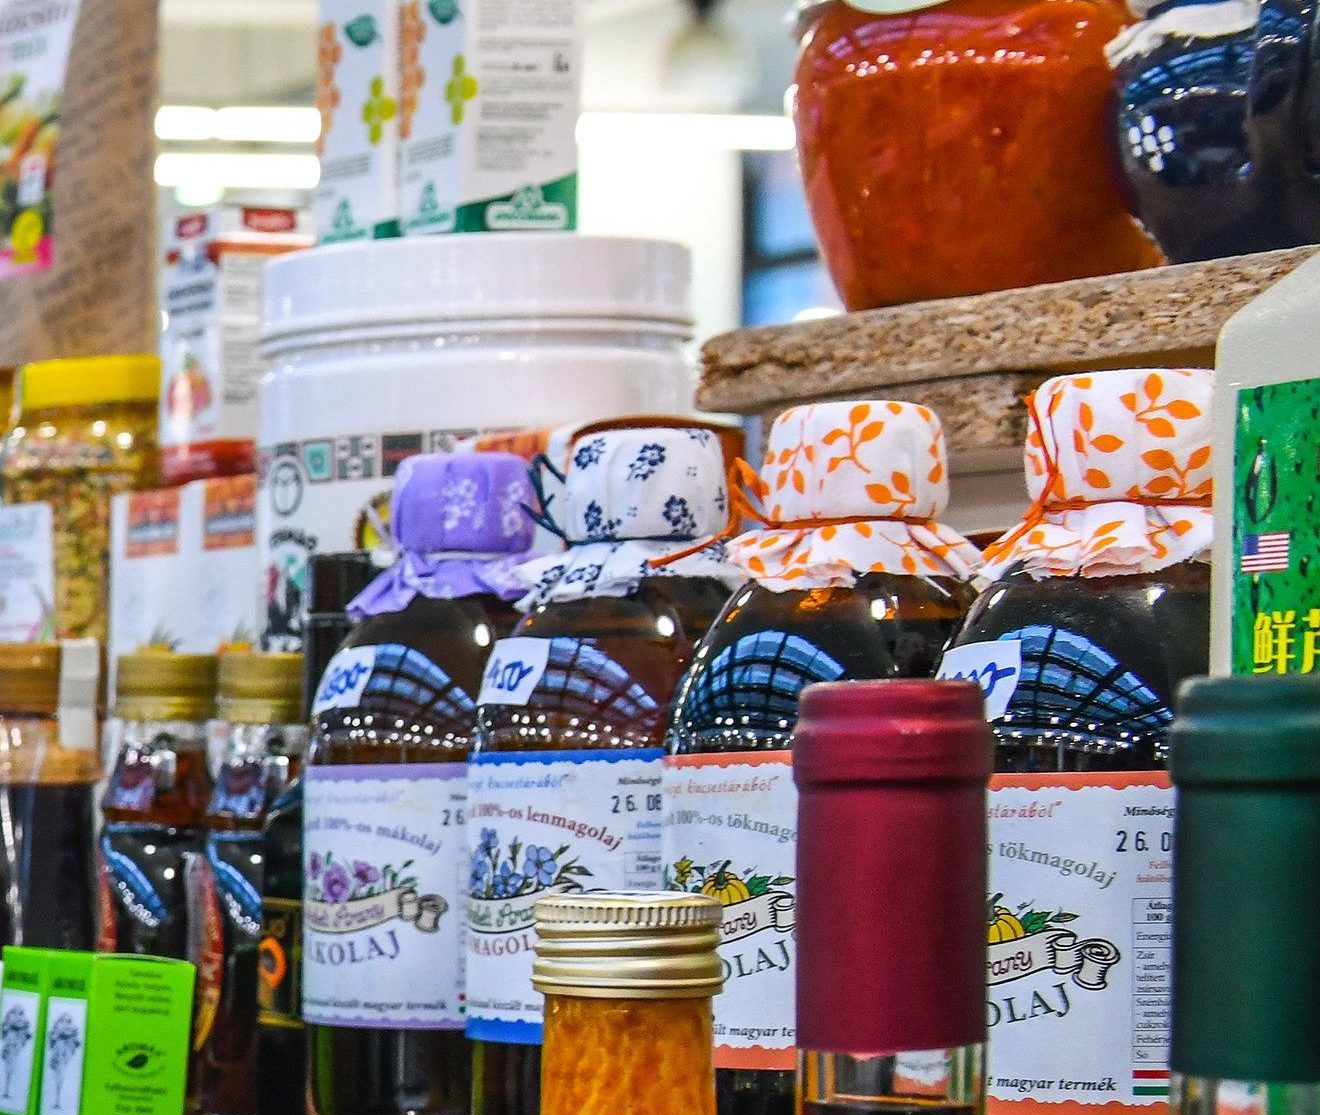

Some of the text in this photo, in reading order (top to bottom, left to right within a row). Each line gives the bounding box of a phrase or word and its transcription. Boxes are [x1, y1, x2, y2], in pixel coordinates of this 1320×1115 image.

[1123, 806, 1175, 818] Minőség
[526, 805, 624, 852] lenmagolaj
[727, 813, 798, 845] tökmago
[998, 840, 1118, 890] tökmagolaj
[310, 929, 401, 967] KOLAJ
[729, 1025, 776, 1038] magyar
[996, 1075, 1118, 1093] magyar termék
